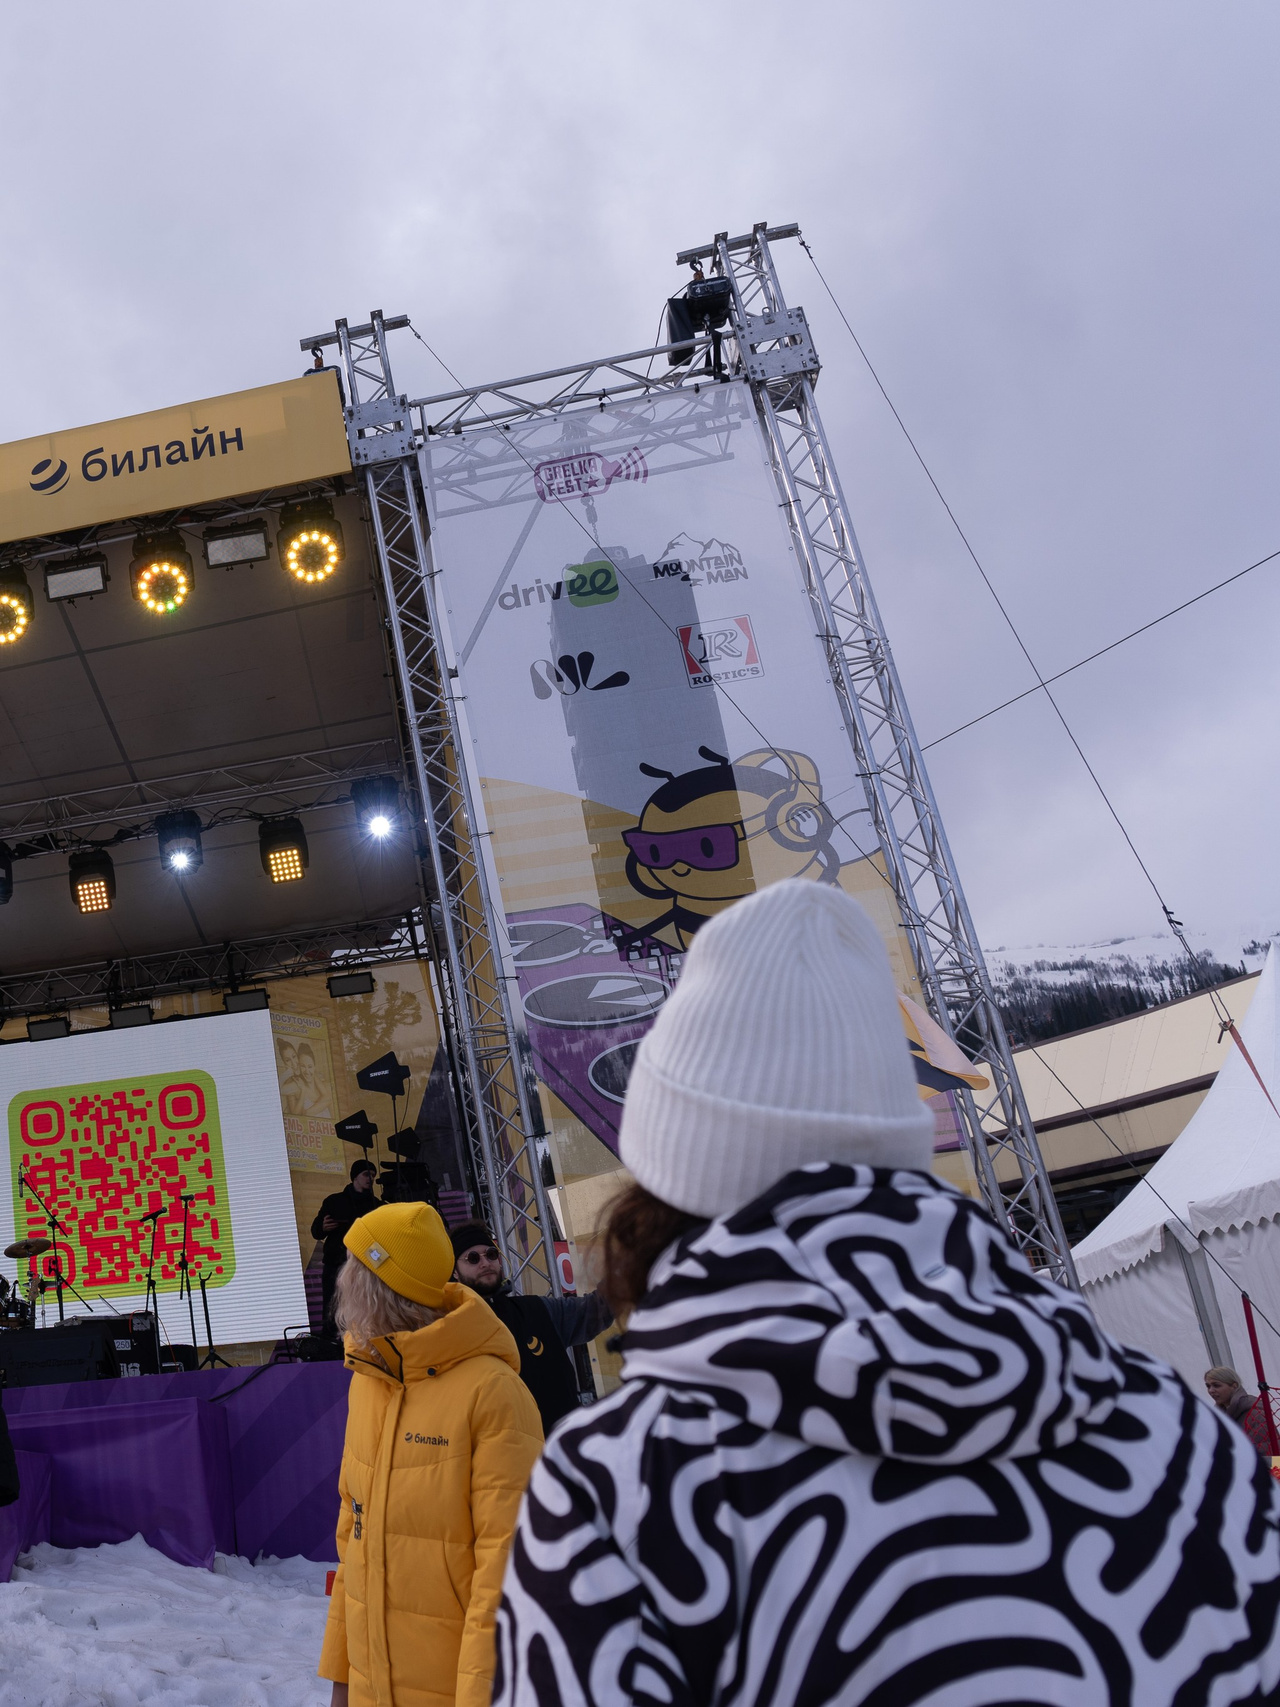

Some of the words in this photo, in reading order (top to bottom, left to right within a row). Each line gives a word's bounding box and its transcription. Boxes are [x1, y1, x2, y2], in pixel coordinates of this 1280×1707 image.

[81, 425, 244, 482] билайн
[544, 458, 598, 482] GRELKA
[548, 478, 583, 497] FEST
[653, 553, 744, 580] MOUNTAIN
[706, 566, 749, 585] MAN
[498, 568, 619, 611] drivee
[692, 666, 761, 686] ROSTIC'S
[369, 1069, 389, 1078] SHURE
[296, 1134, 322, 1149] ГОРЕ
[116, 1341, 130, 1349] 250
[414, 1432, 449, 1447] билайн
